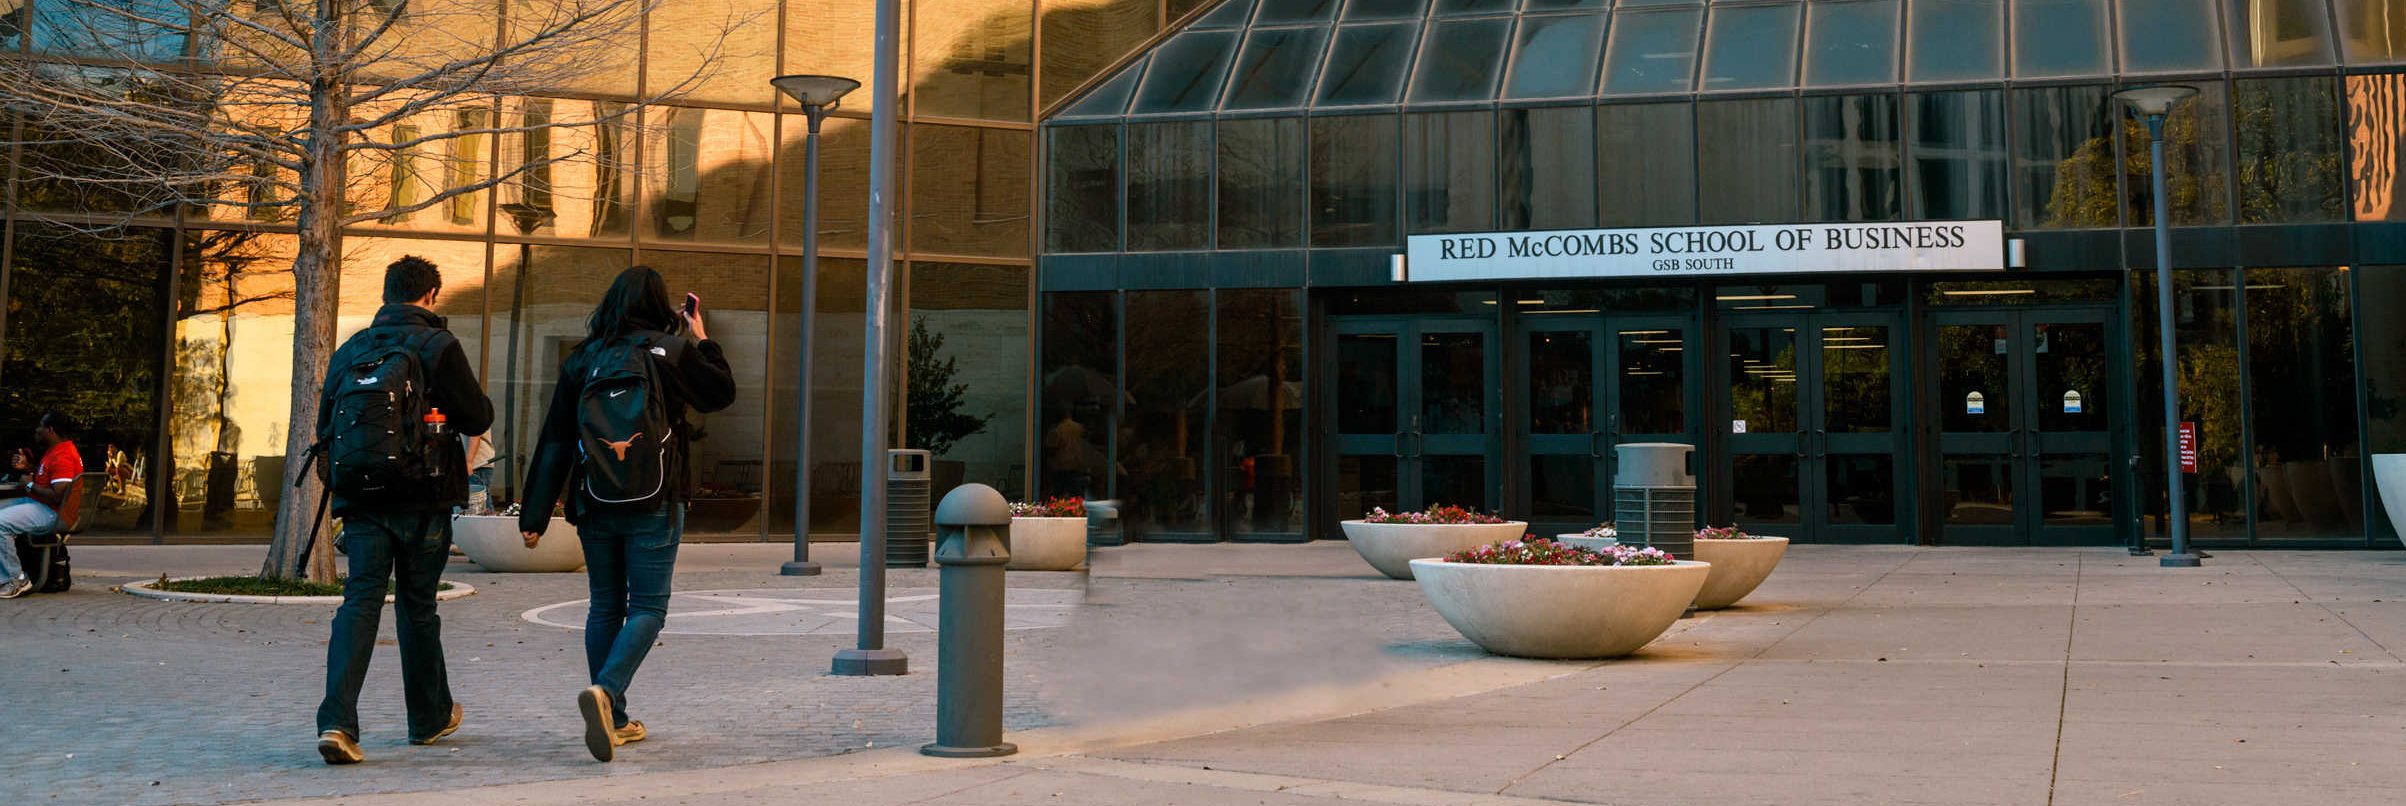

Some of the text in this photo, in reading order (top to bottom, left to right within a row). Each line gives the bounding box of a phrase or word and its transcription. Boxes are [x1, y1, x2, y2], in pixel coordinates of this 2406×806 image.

[1440, 225, 1965, 260] RED McCOMBS SCHOOL OF BUSINESS
[1652, 258, 1734, 271] GSB SOUTH
